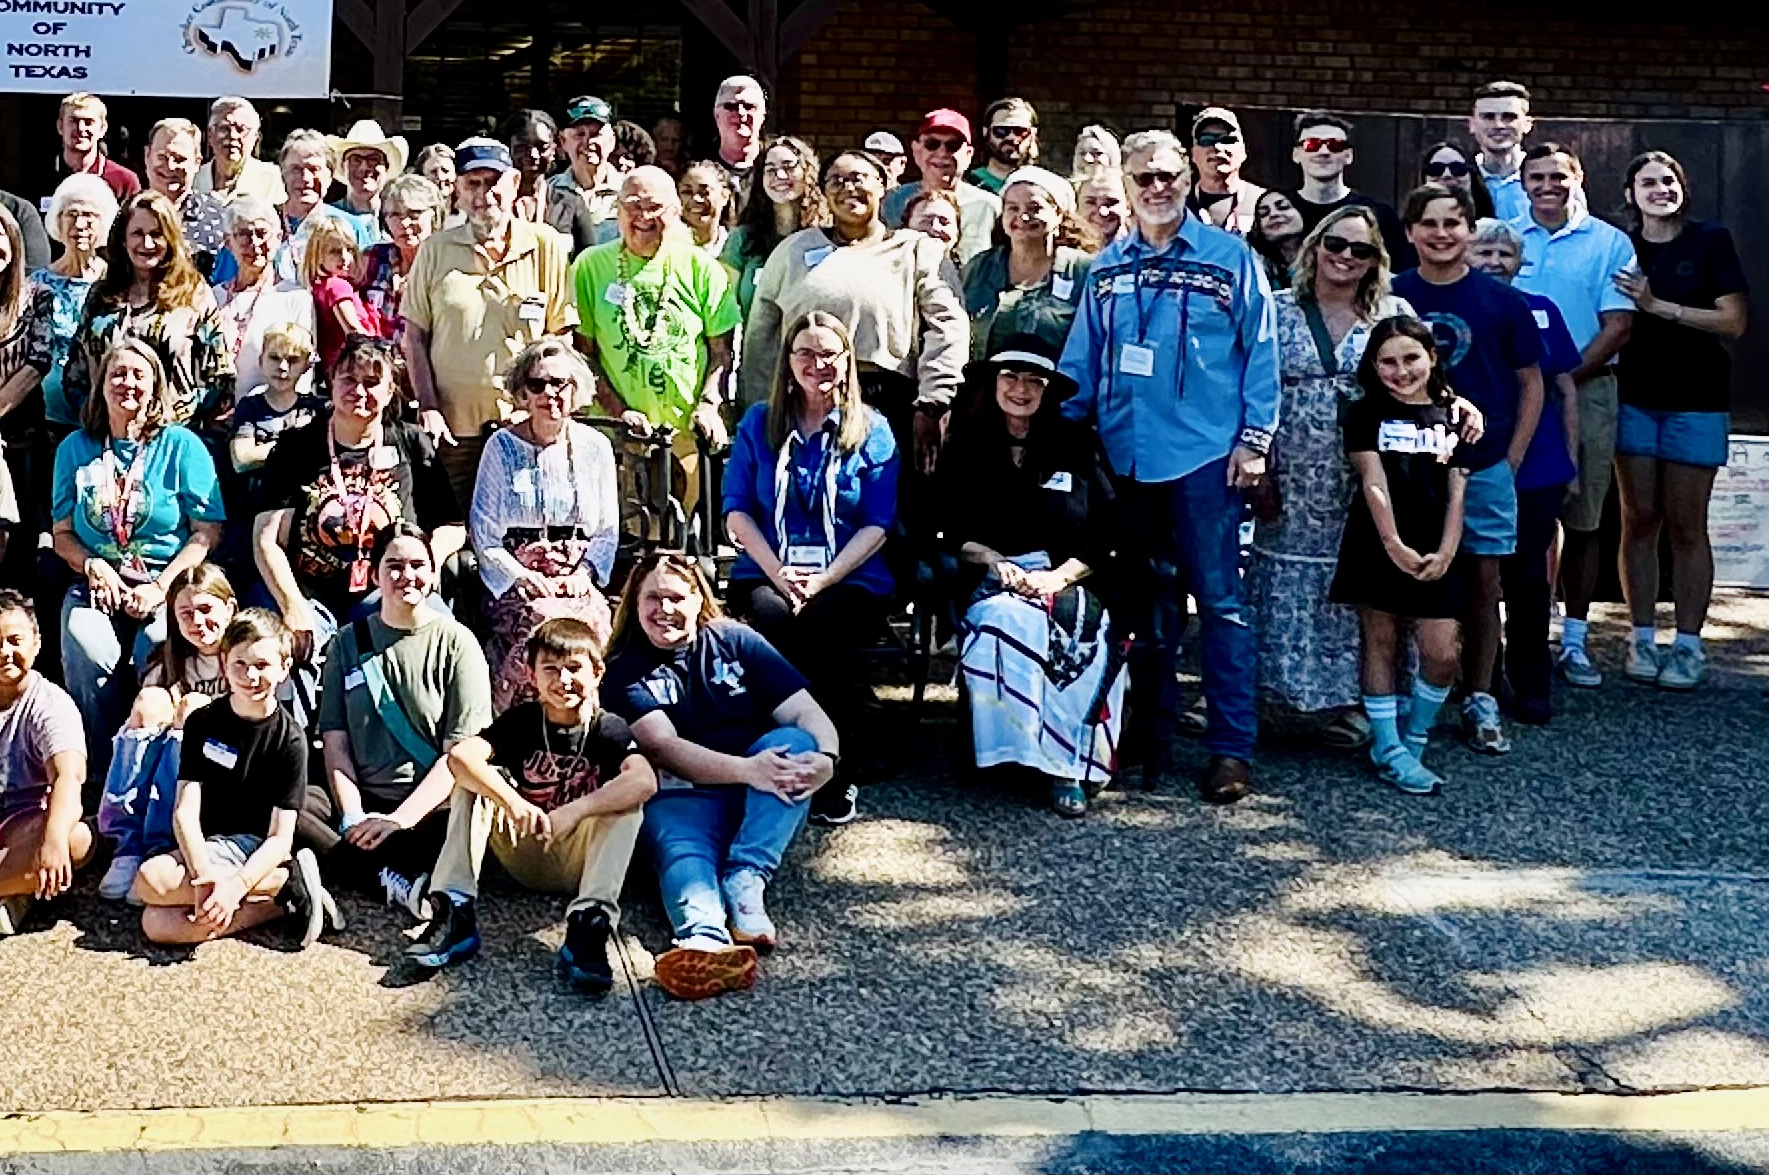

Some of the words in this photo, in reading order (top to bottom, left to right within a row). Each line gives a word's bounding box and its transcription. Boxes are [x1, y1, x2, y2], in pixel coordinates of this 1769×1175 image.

[32, 22, 67, 35] OF
[7, 43, 91, 58] NORTH
[9, 64, 88, 79] TEXAS
